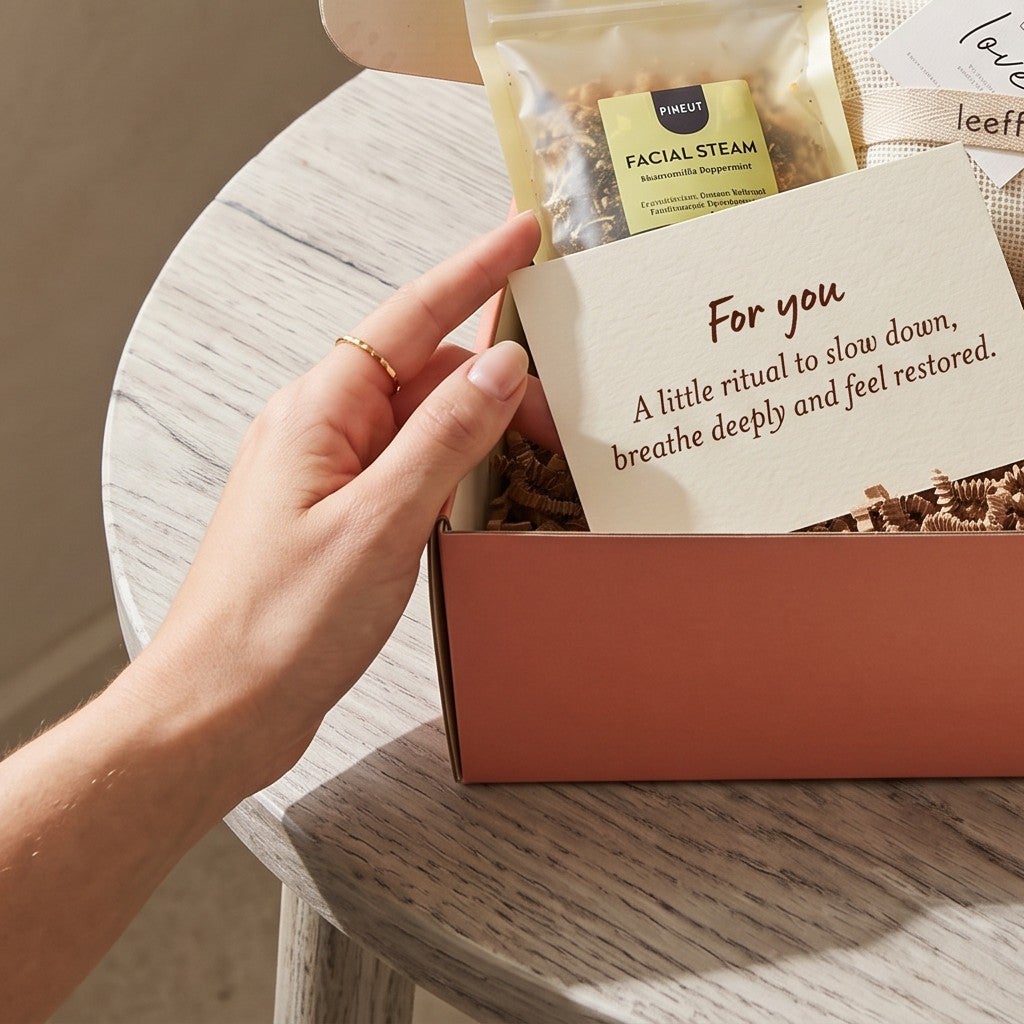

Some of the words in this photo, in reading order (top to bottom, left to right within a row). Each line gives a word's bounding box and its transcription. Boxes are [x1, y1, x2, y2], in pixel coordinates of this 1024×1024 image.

[659, 101, 703, 116] PINEUT
[625, 146, 693, 169] FACIAL
[696, 140, 758, 158] STEAM
[708, 295, 765, 343] For
[777, 282, 846, 339] you
[633, 394, 654, 424] A
[657, 377, 714, 416] little
[720, 352, 789, 396] ritual
[795, 352, 819, 374] to
[826, 335, 877, 366] slow
[885, 314, 958, 347] down,
[611, 425, 704, 471] breathe
[711, 398, 785, 439] deeply
[794, 378, 839, 417] and
[844, 364, 888, 411] feel
[893, 333, 997, 387] restored.
